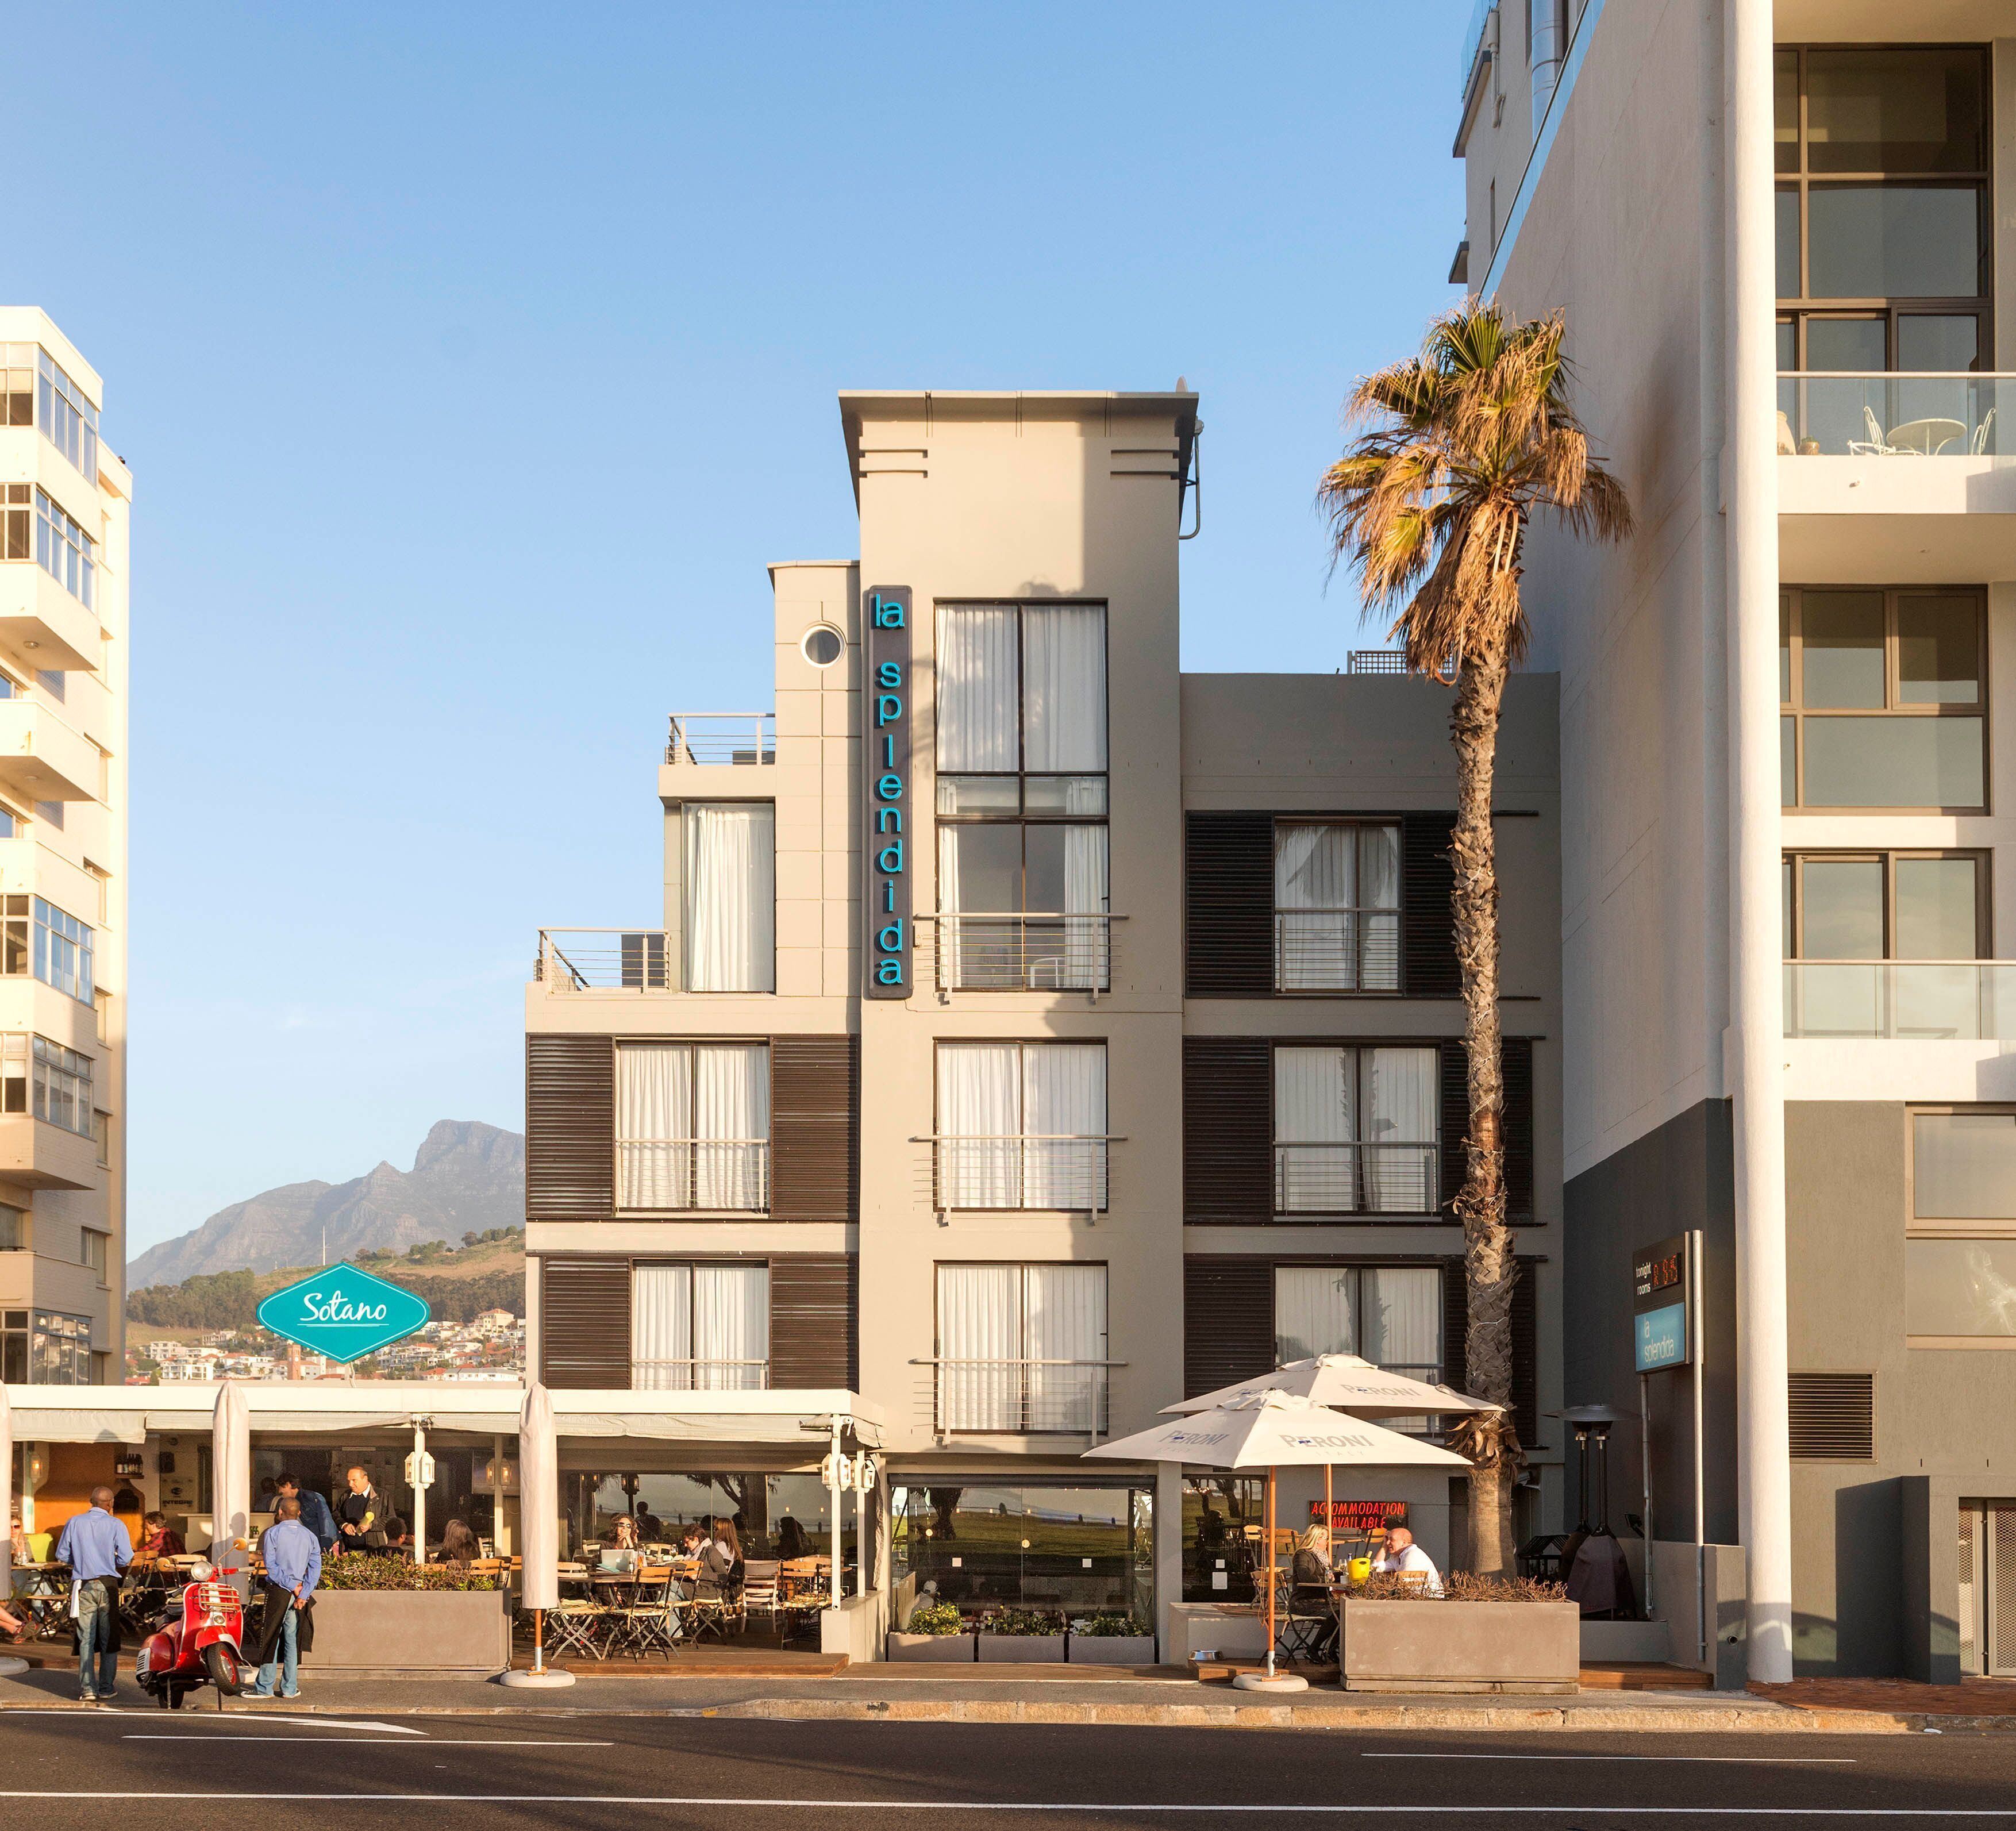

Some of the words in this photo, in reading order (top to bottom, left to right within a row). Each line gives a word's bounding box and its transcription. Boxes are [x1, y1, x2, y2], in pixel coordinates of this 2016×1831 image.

[875, 594, 905, 630] la
[879, 661, 903, 985] splendida
[1636, 1261, 1651, 1279] tonight
[1637, 1283, 1651, 1296] rooms
[299, 1290, 387, 1321] Sotano
[1644, 1316, 1650, 1338] la
[1645, 1333, 1675, 1366] splendida
[1340, 1384, 1423, 1397] PERONI
[1159, 1430, 1230, 1445] PERONI
[1279, 1434, 1375, 1448] PERONI
[1332, 1517, 1387, 1529] AVAILABLE
